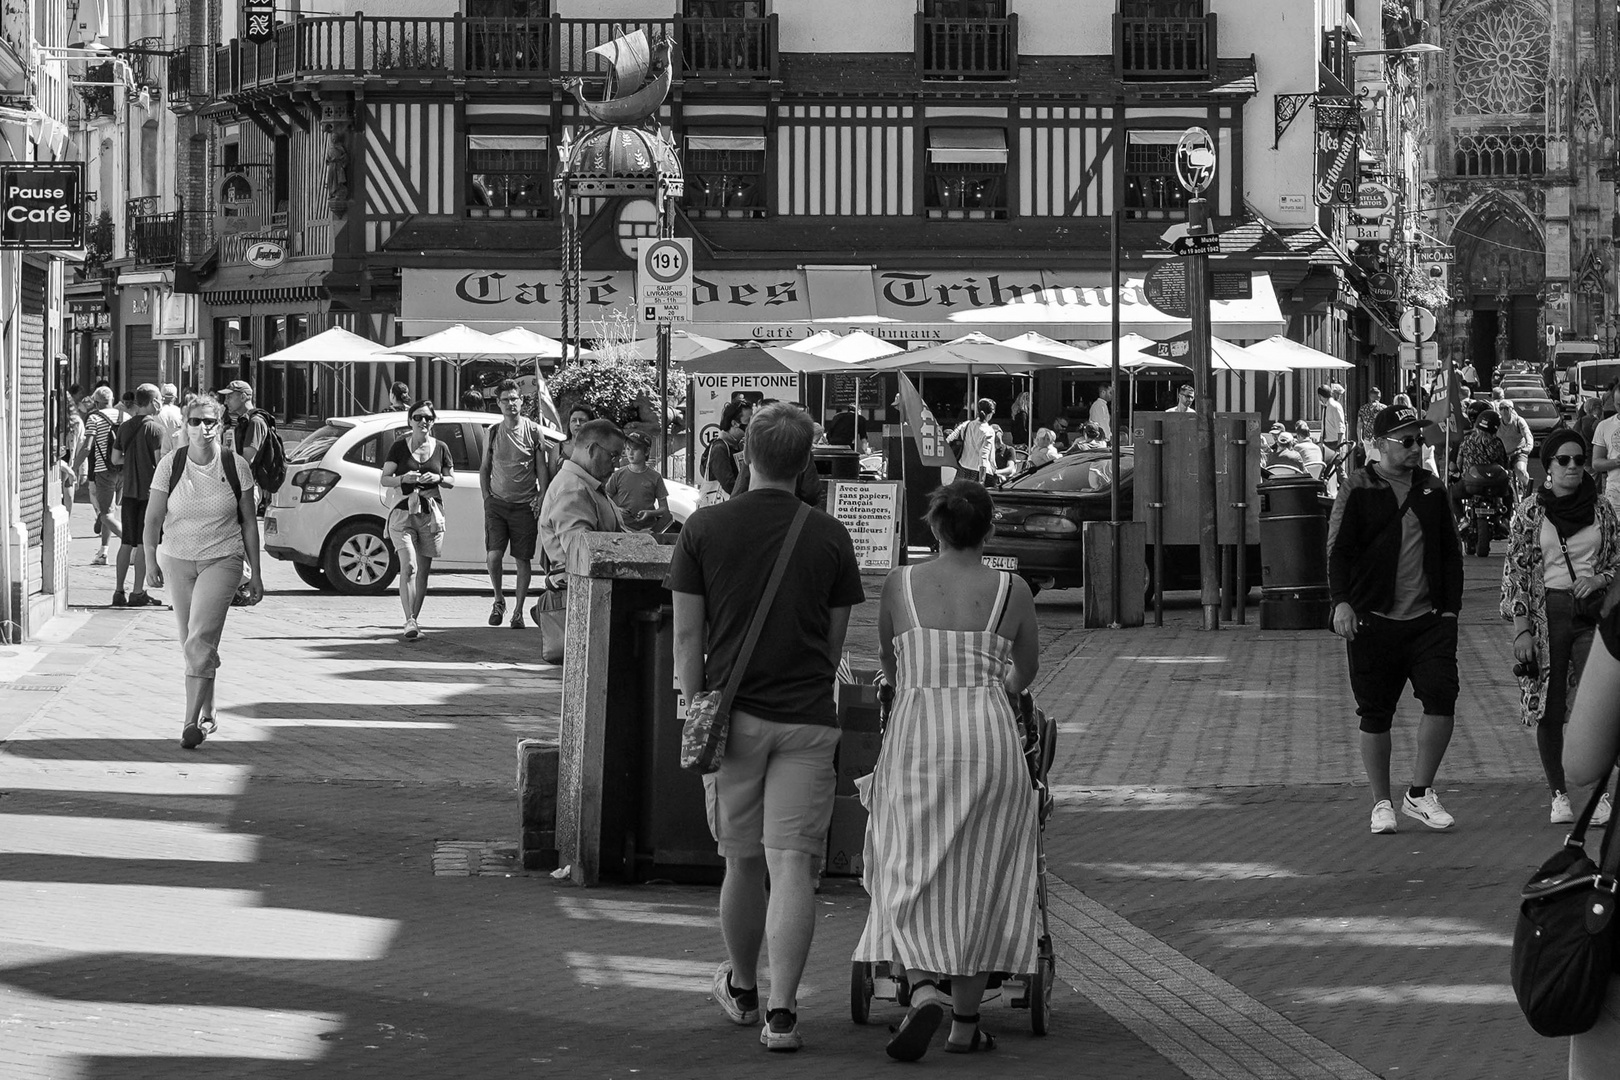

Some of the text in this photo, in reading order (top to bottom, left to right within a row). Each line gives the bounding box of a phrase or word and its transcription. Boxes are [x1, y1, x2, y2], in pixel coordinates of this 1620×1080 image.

[9, 186, 64, 199] Pause
[7, 204, 72, 223] Café
[1357, 226, 1379, 238] Bar
[653, 253, 680, 269] 19 t
[1421, 250, 1454, 261] NICOLAS
[455, 272, 619, 306] Café
[692, 274, 799, 306] des
[752, 326, 793, 338] Café
[698, 376, 798, 387] VOIE PIETONNE
[858, 492, 891, 500] papiers,
[849, 506, 891, 514] étrangers,
[872, 545, 888, 553] pas
